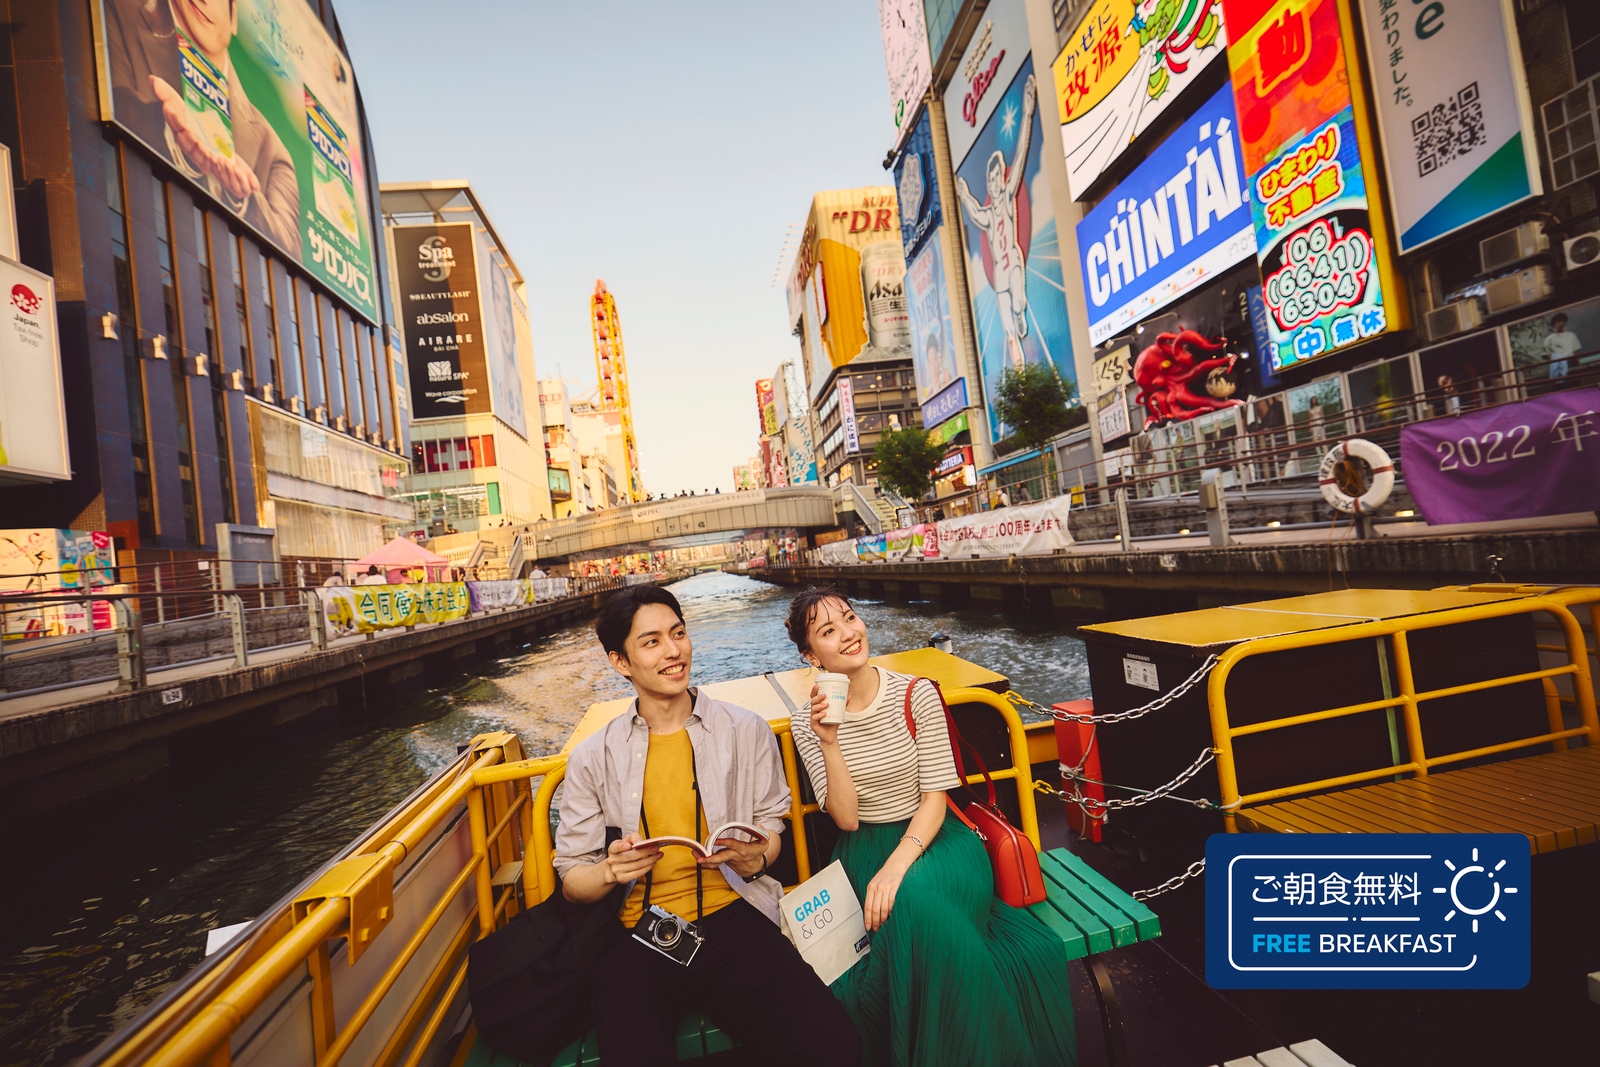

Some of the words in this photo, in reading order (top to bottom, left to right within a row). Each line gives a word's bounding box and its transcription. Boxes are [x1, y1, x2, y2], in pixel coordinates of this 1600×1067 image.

[1063, 16, 1122, 118] 改源
[1065, 4, 1111, 77] かぜに
[963, 49, 1005, 127] Glico
[1260, 129, 1337, 197] ひまわり
[1087, 128, 1242, 306] CHINTAI
[1267, 165, 1341, 227] 不動産
[307, 227, 374, 307] サロンパス
[418, 244, 454, 264] Spa
[1291, 226, 1326, 262] 06
[416, 311, 469, 325] abSalon
[1283, 273, 1355, 322] 6304
[1436, 424, 1536, 472] 2022
[1549, 409, 1599, 452] 年
[794, 889, 831, 922] GRAB
[801, 923, 813, 940] &
[813, 908, 834, 930] GO
